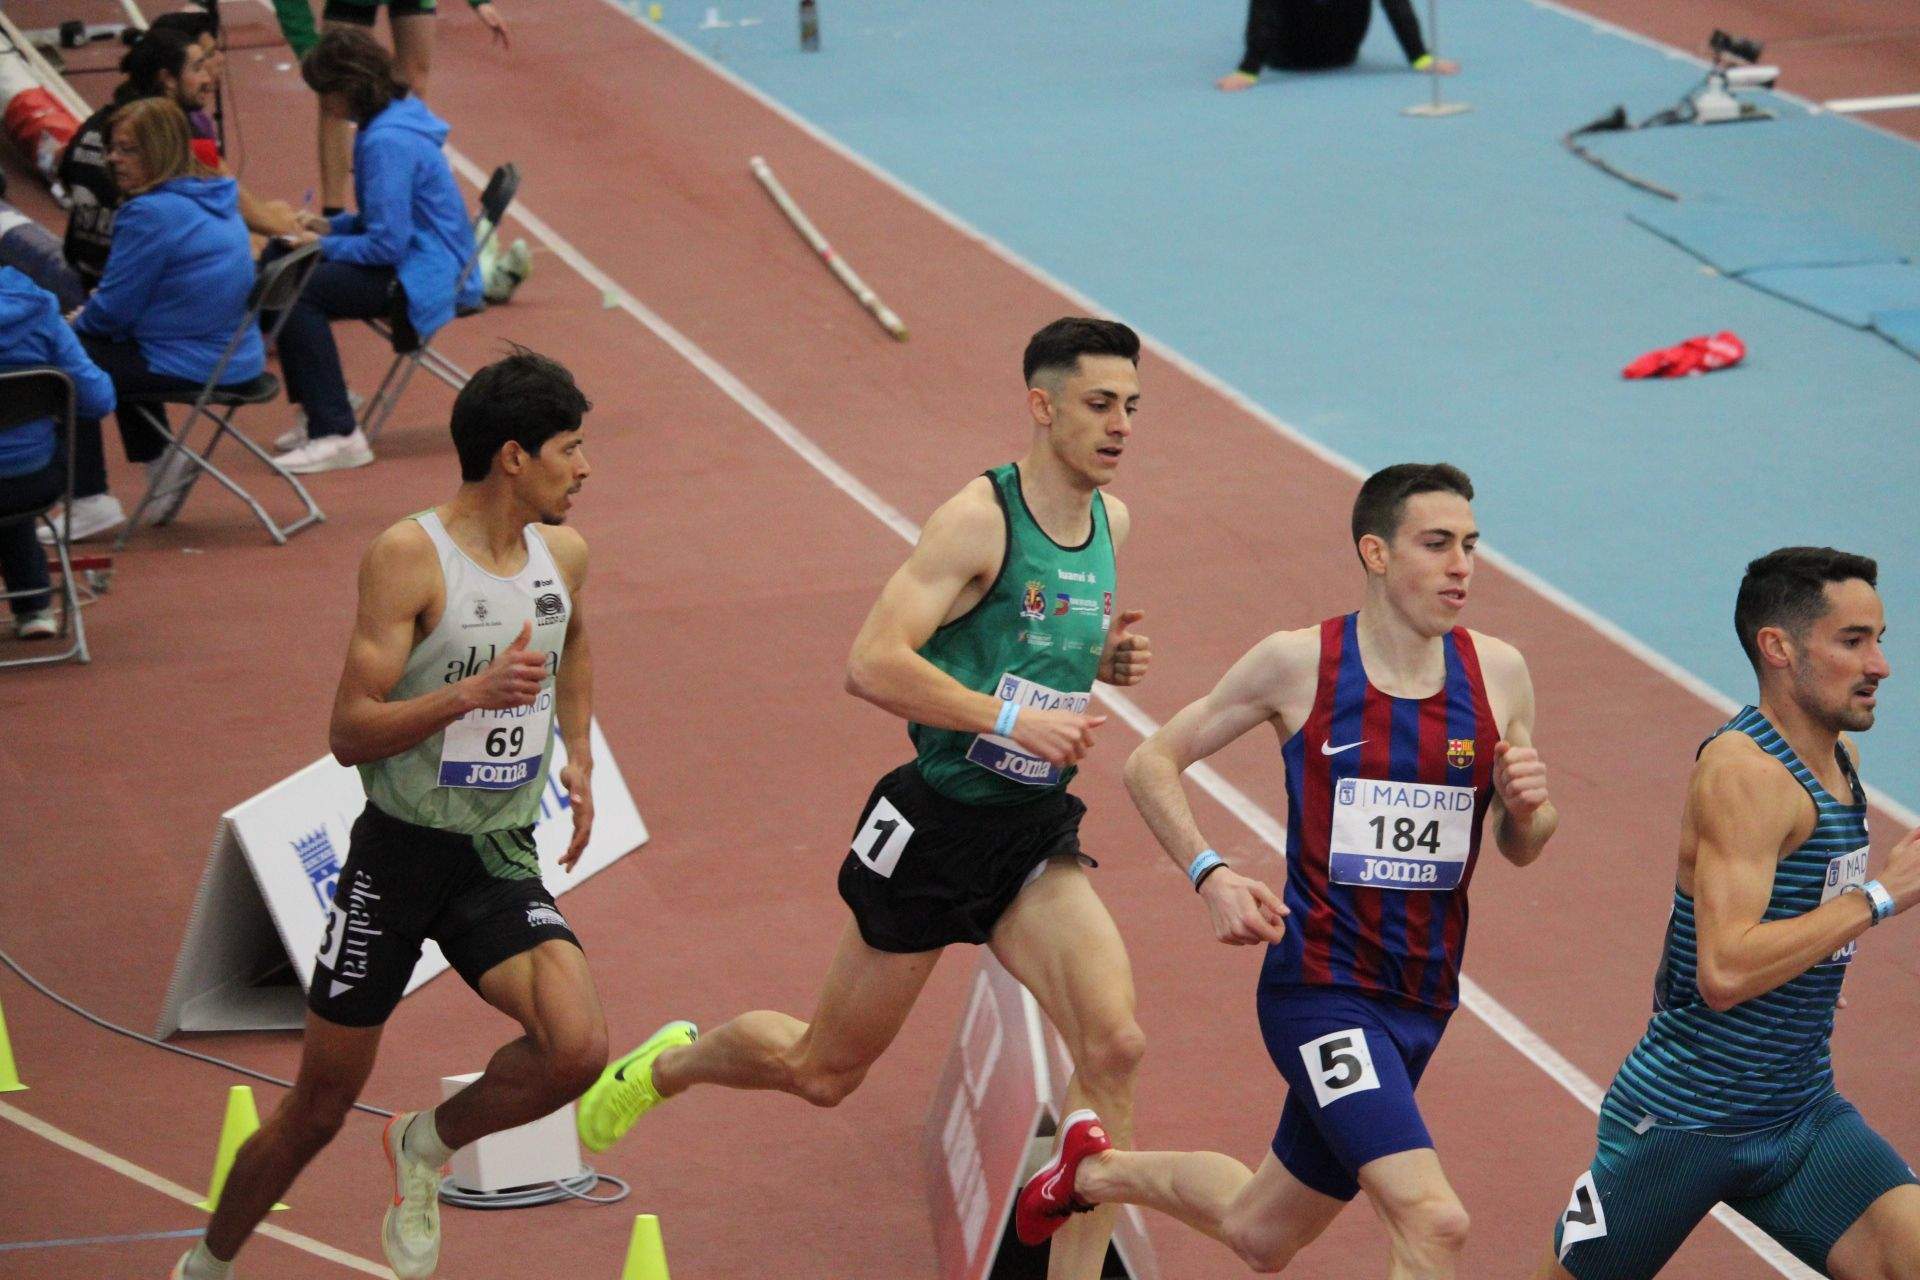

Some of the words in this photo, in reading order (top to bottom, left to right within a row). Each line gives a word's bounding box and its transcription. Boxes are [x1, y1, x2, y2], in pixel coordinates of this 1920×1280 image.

[485, 726, 524, 758] 69
[1373, 785, 1473, 812] MADRID
[867, 818, 900, 863] 1
[1368, 815, 1441, 854] 184
[1318, 1036, 1363, 1090] 5
